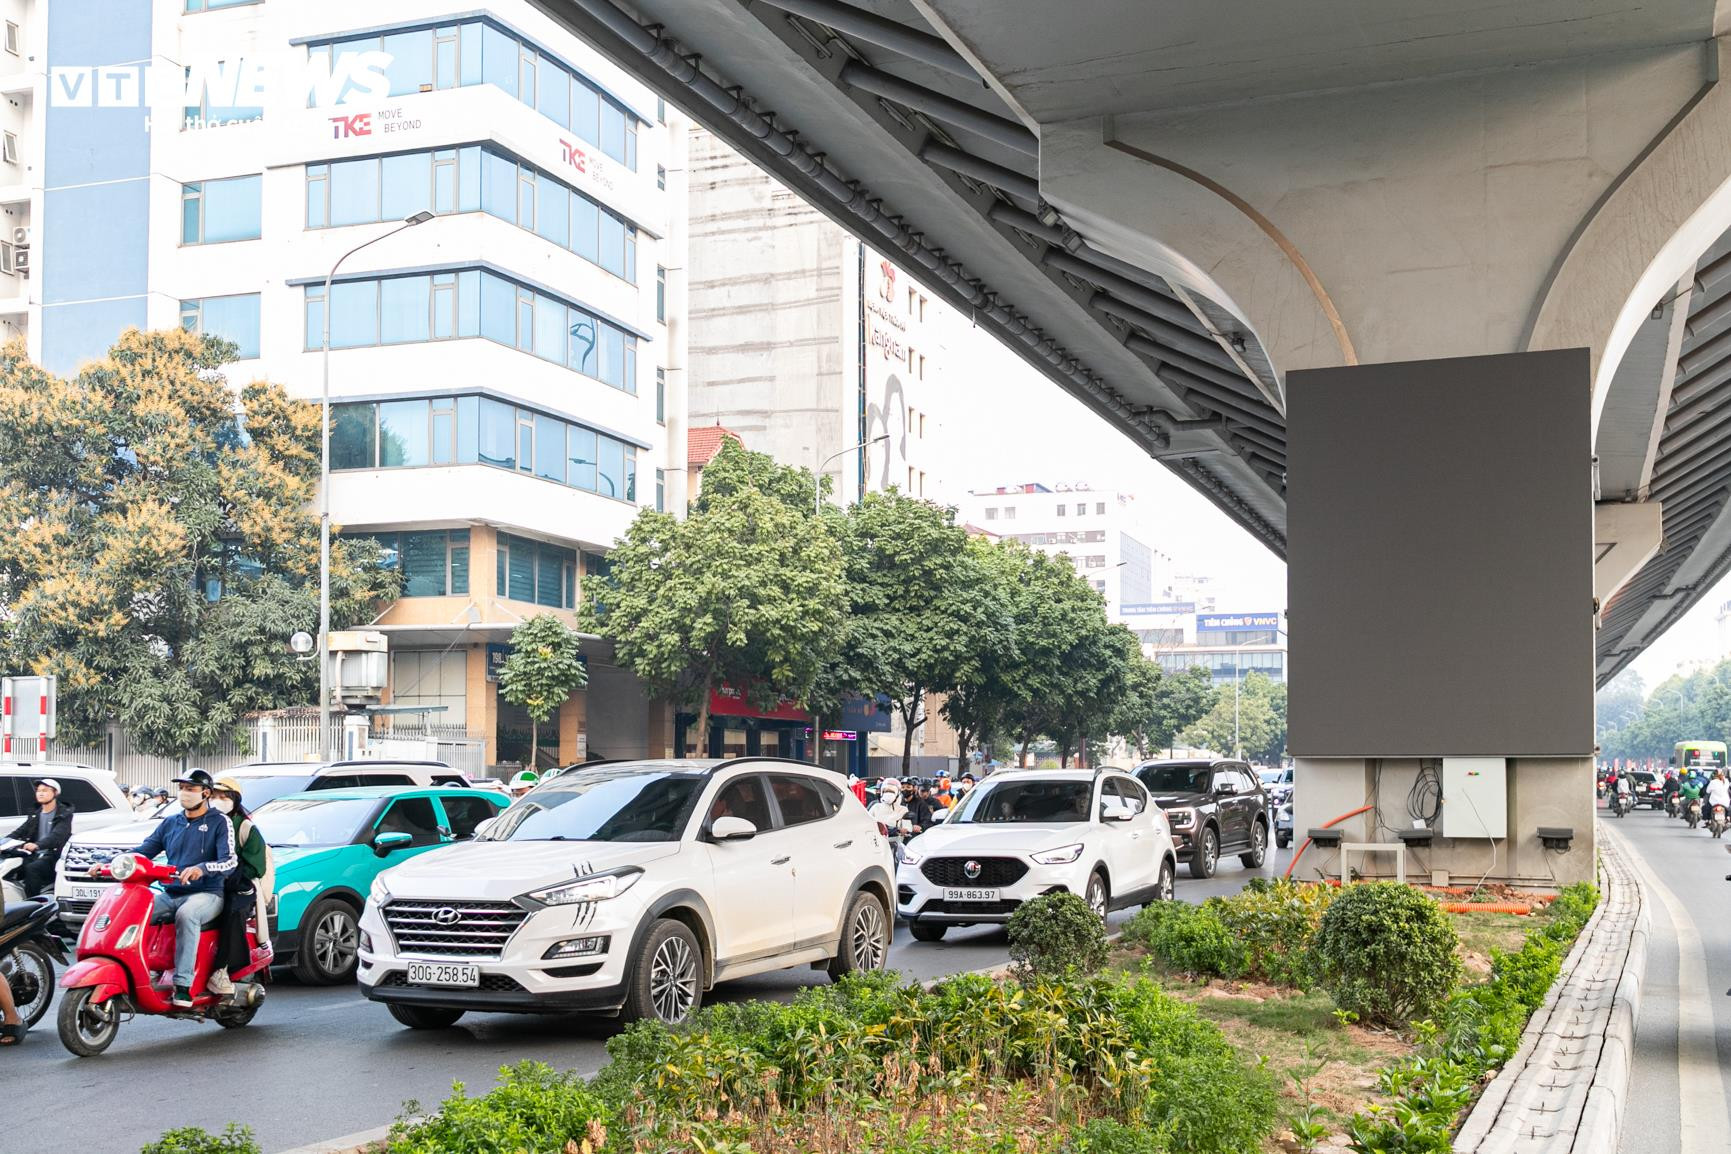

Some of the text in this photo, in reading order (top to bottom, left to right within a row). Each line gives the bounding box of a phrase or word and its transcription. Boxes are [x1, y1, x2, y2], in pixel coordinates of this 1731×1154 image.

[378, 108, 402, 120] MOVE
[328, 113, 372, 139] TKE
[384, 119, 422, 133] BEYOND
[559, 138, 586, 174] TKE
[1253, 617, 1277, 626] VNVC
[948, 890, 995, 899] 99A-863.97
[410, 965, 477, 984] 30G-258.54
